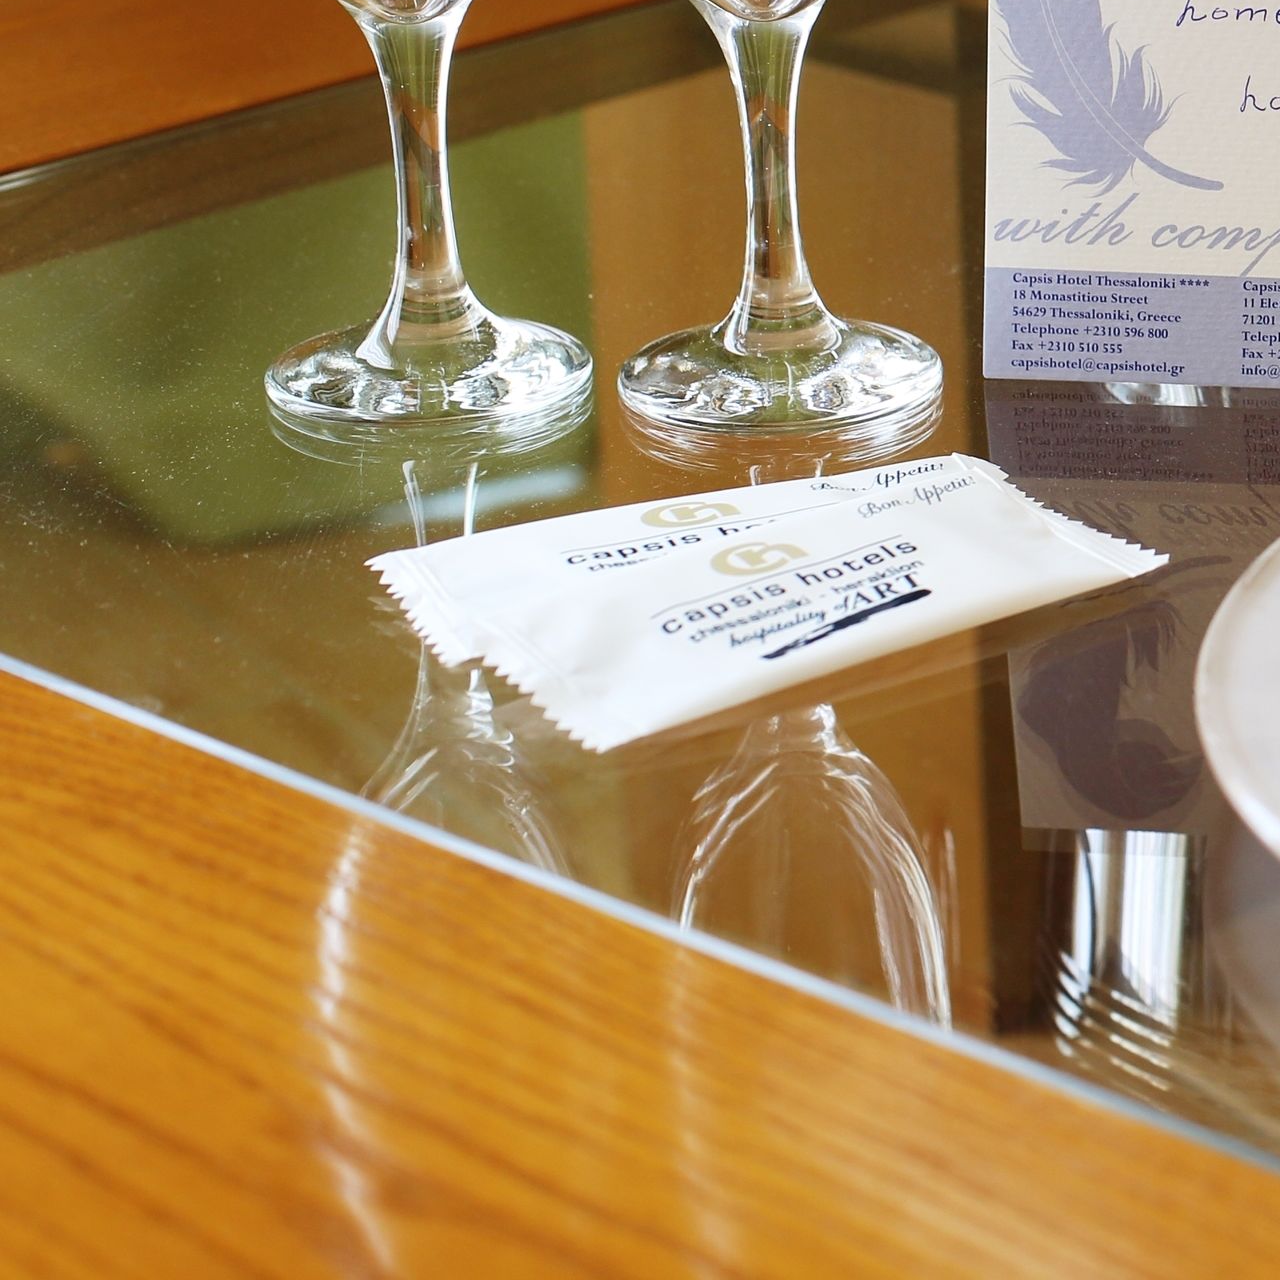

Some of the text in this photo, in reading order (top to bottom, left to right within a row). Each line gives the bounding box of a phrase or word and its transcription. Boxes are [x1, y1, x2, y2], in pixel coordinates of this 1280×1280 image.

[993, 192, 1139, 246] with
[1012, 272, 1053, 287] Capsis
[1056, 274, 1092, 286] Hotel
[1095, 275, 1176, 289] Thessaloniki
[1013, 289, 1026, 300] 18
[1110, 292, 1149, 305] Street
[1243, 297, 1255, 308] 11
[1012, 306, 1182, 323] 54629 Thessaloniki, Greece
[1242, 314, 1276, 326] 71201
[1012, 323, 1169, 339] Telephone +2310 596 800
[1012, 339, 1123, 354] Fax +2310 510 555
[1242, 348, 1264, 359] Fax
[1011, 356, 1185, 377] capsishotel@capsishotel.gr
[857, 498, 903, 518] Bon
[566, 532, 701, 566] capsis
[661, 540, 919, 636] capsis hotels
[851, 570, 920, 610] ART
